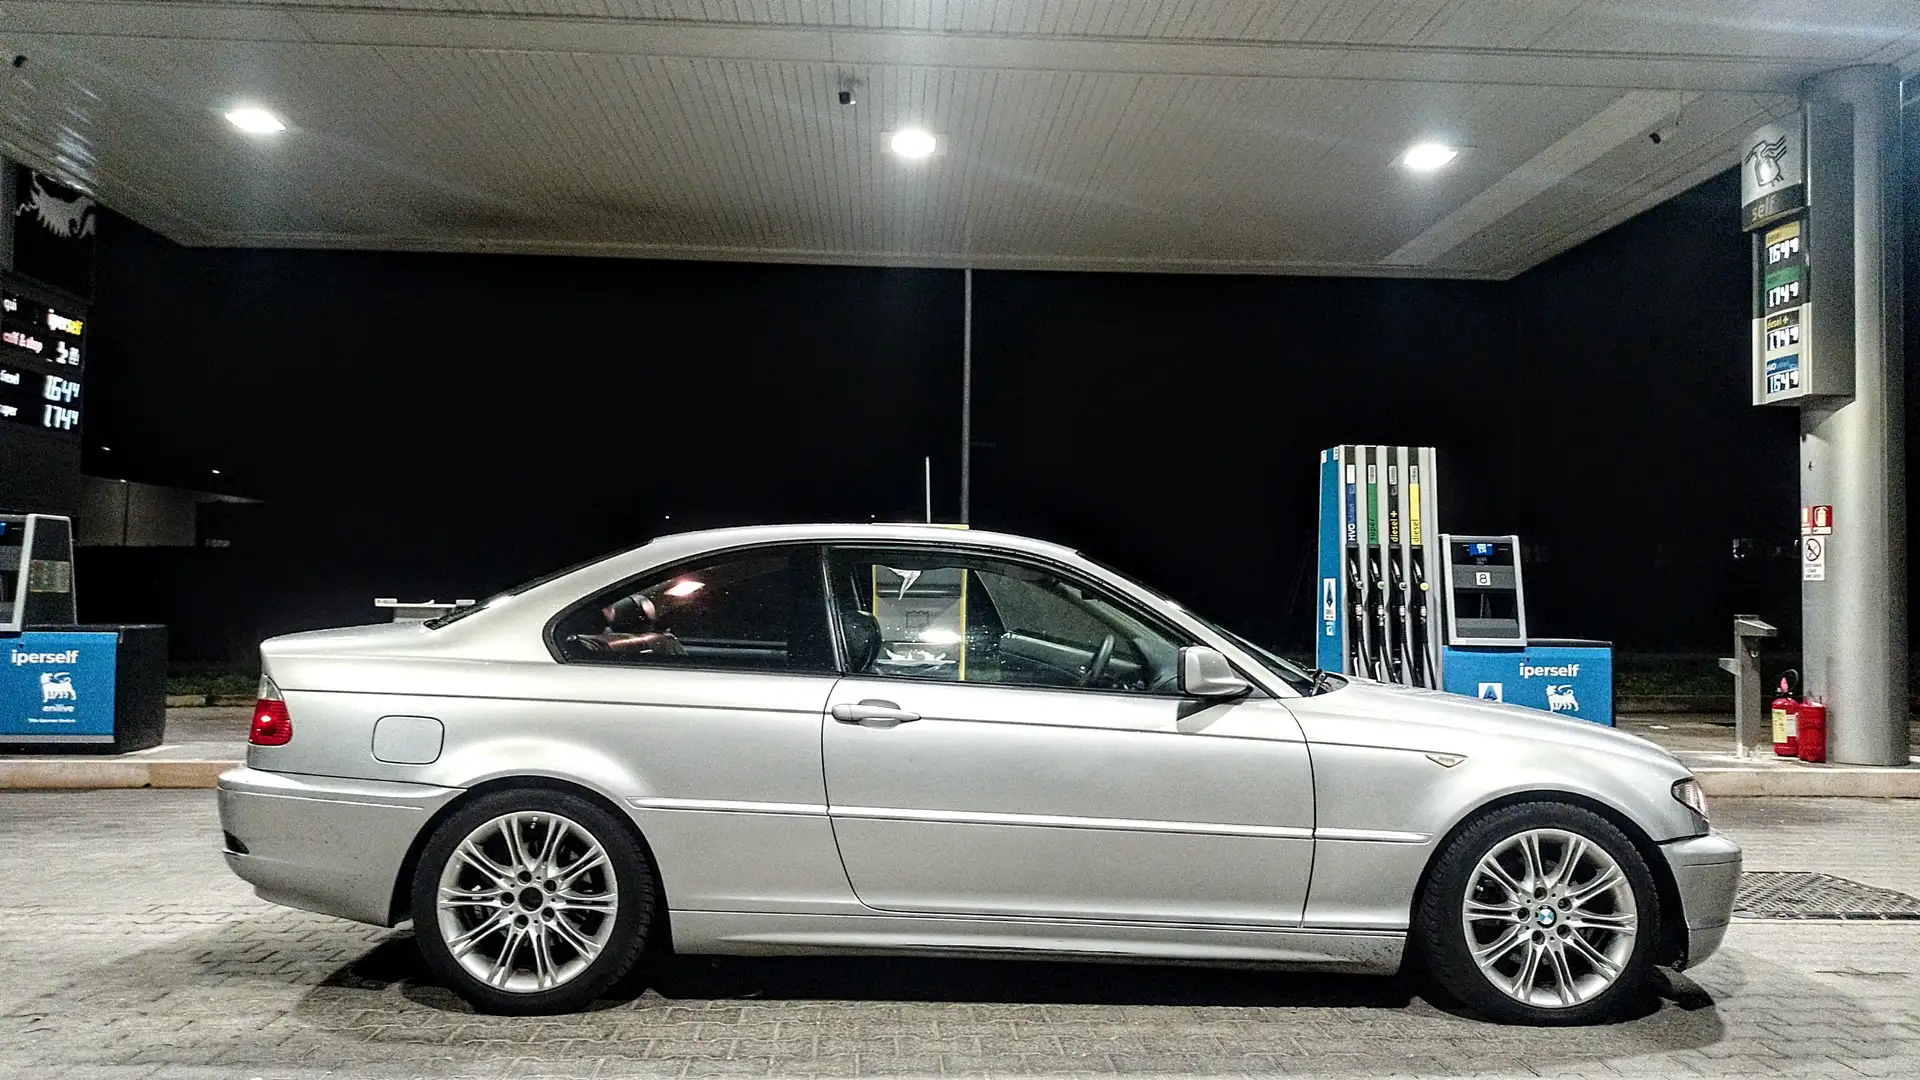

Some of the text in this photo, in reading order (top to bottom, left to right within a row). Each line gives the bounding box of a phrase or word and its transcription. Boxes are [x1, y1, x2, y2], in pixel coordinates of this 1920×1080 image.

[1369, 519, 1377, 541] super
[1390, 519, 1399, 543] diesel
[1411, 519, 1420, 543] diesel
[11, 649, 80, 666] iperself
[1519, 662, 1580, 679] iperself
[1483, 684, 1498, 701] A
